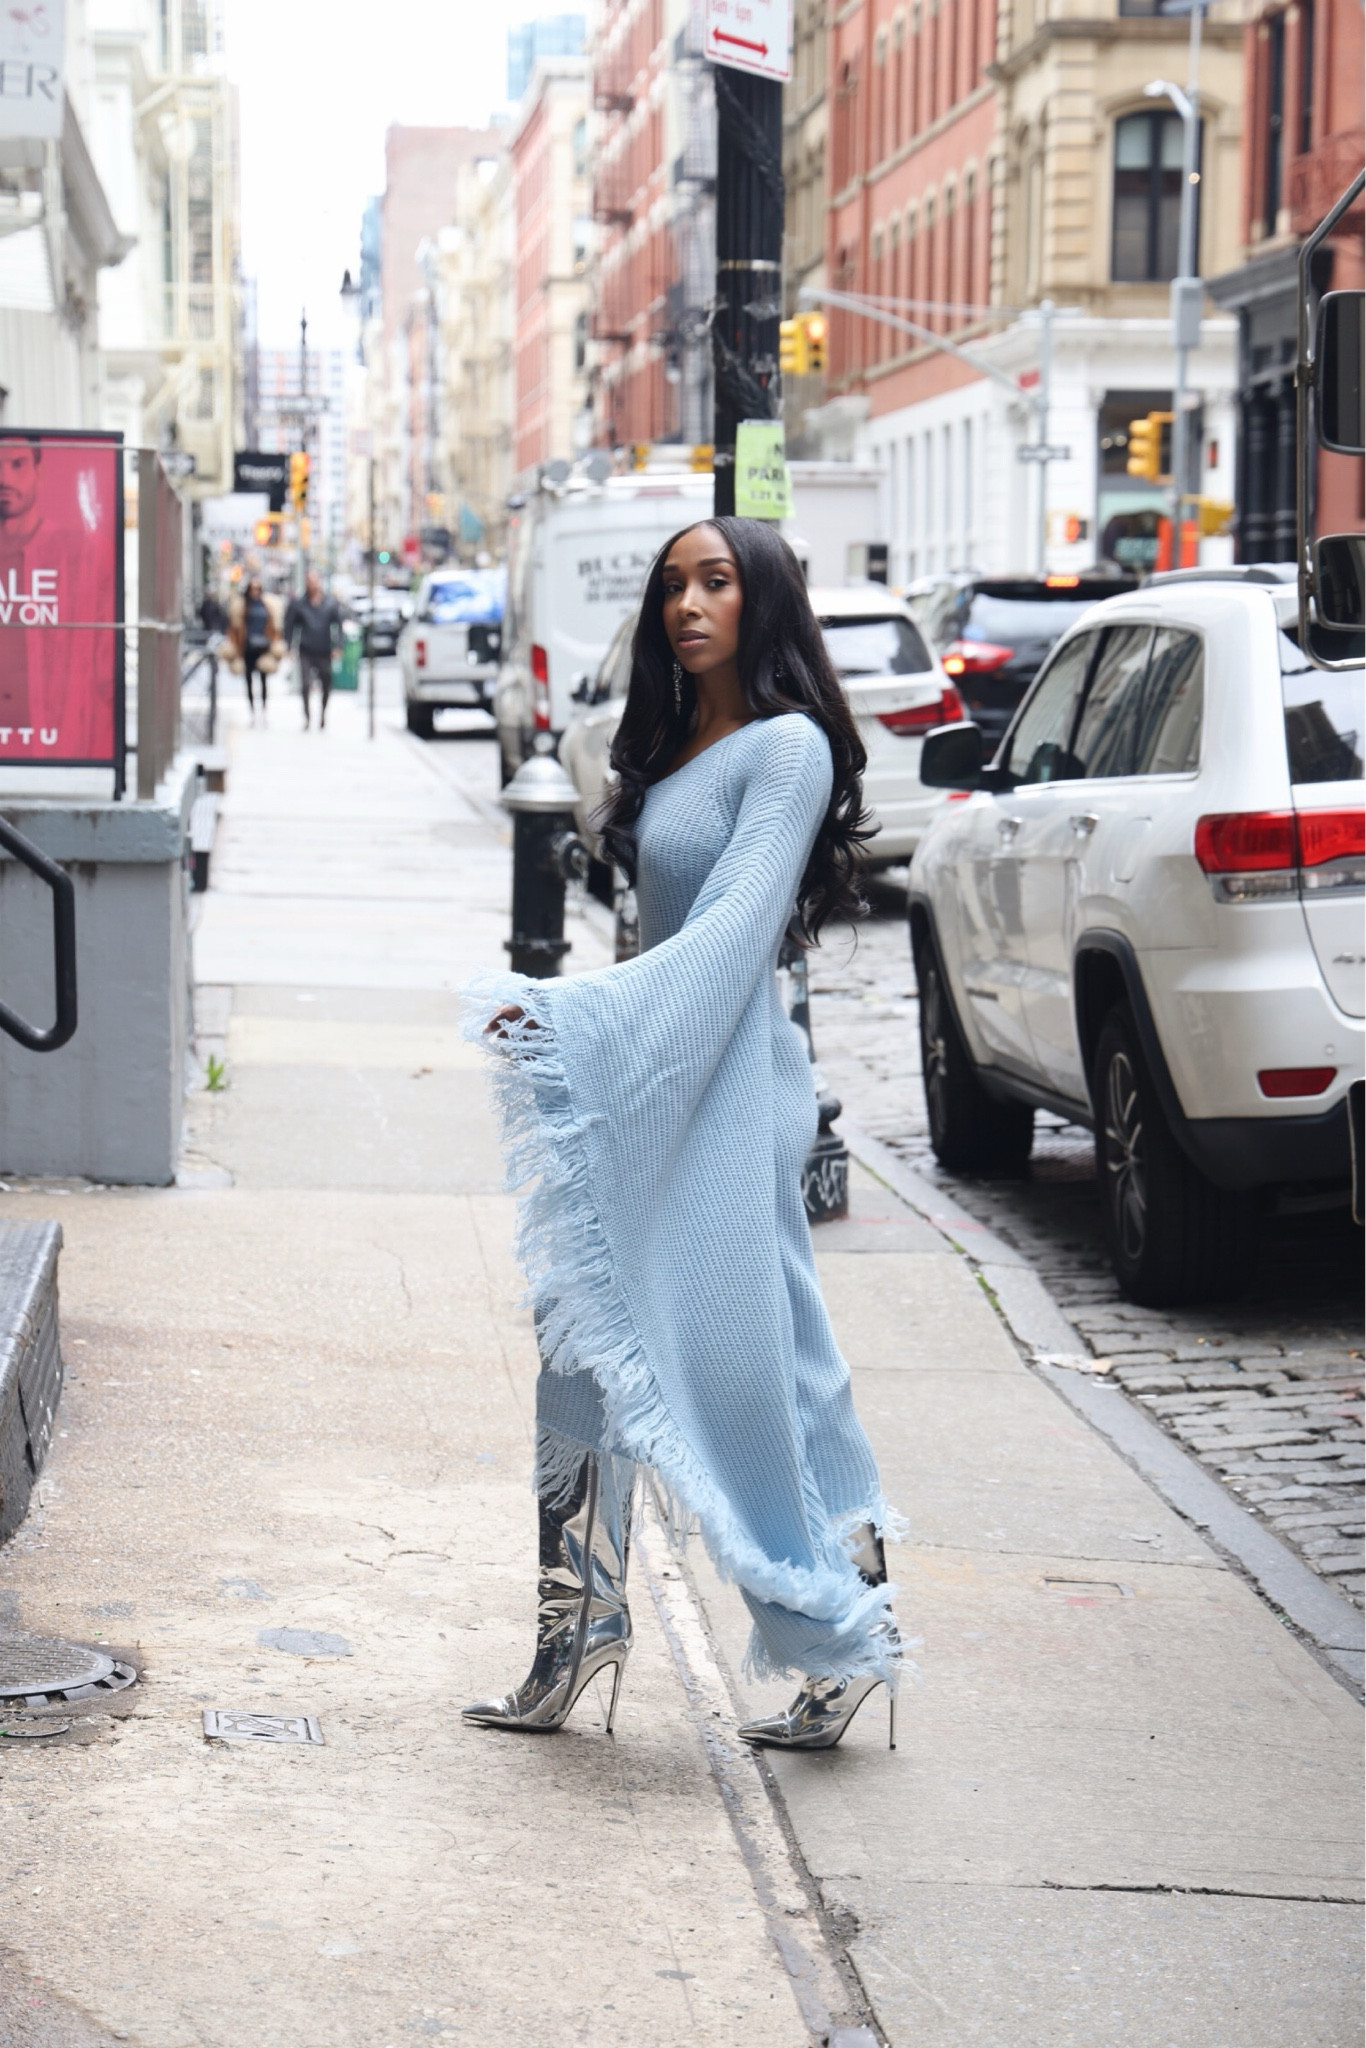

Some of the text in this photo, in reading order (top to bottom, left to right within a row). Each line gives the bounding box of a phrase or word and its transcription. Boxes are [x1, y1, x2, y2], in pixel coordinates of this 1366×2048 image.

[0, 568, 58, 602] LE
[19, 603, 58, 625] ON
[0, 727, 58, 745] TTU
